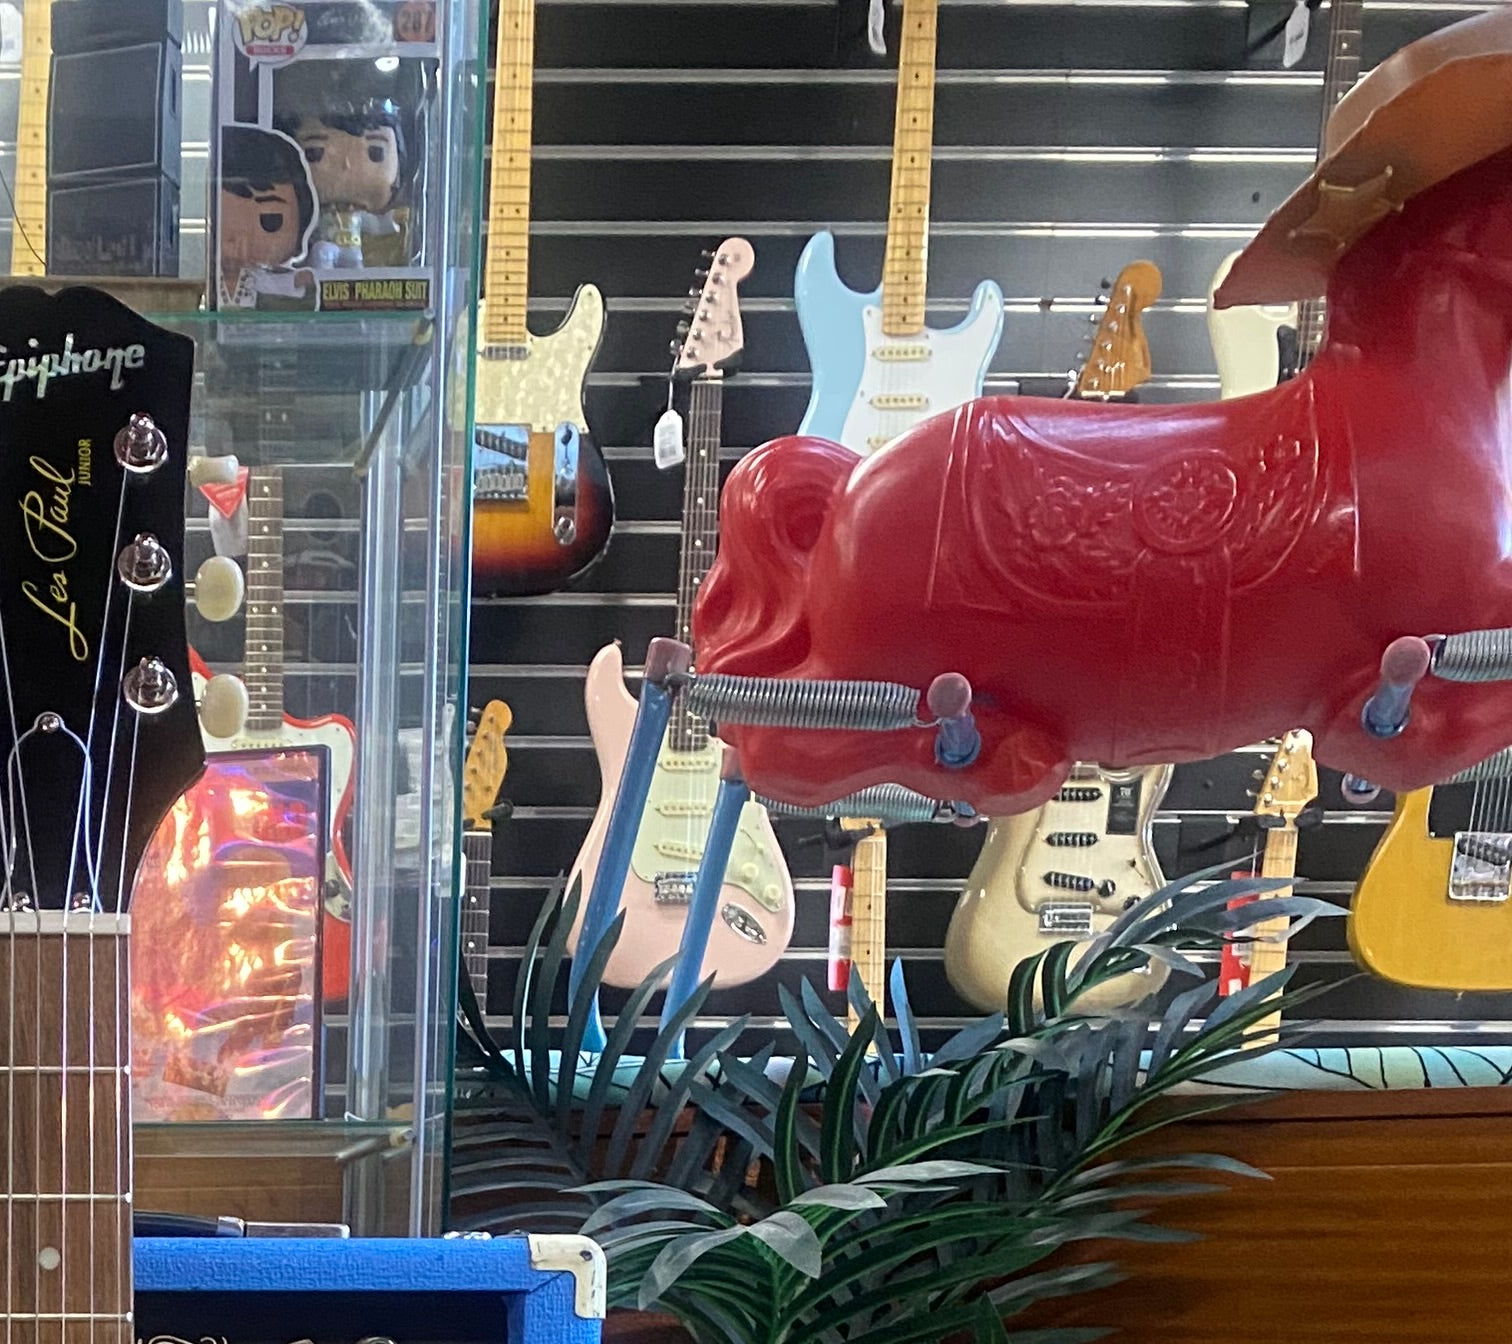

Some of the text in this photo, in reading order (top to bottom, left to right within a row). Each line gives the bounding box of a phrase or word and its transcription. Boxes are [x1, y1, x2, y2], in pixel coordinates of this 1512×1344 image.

[322, 281, 427, 300] ELVIS PHARAOH SUIT
[77, 438, 92, 486] JUNIOR
[18, 455, 89, 661] Les Paul
